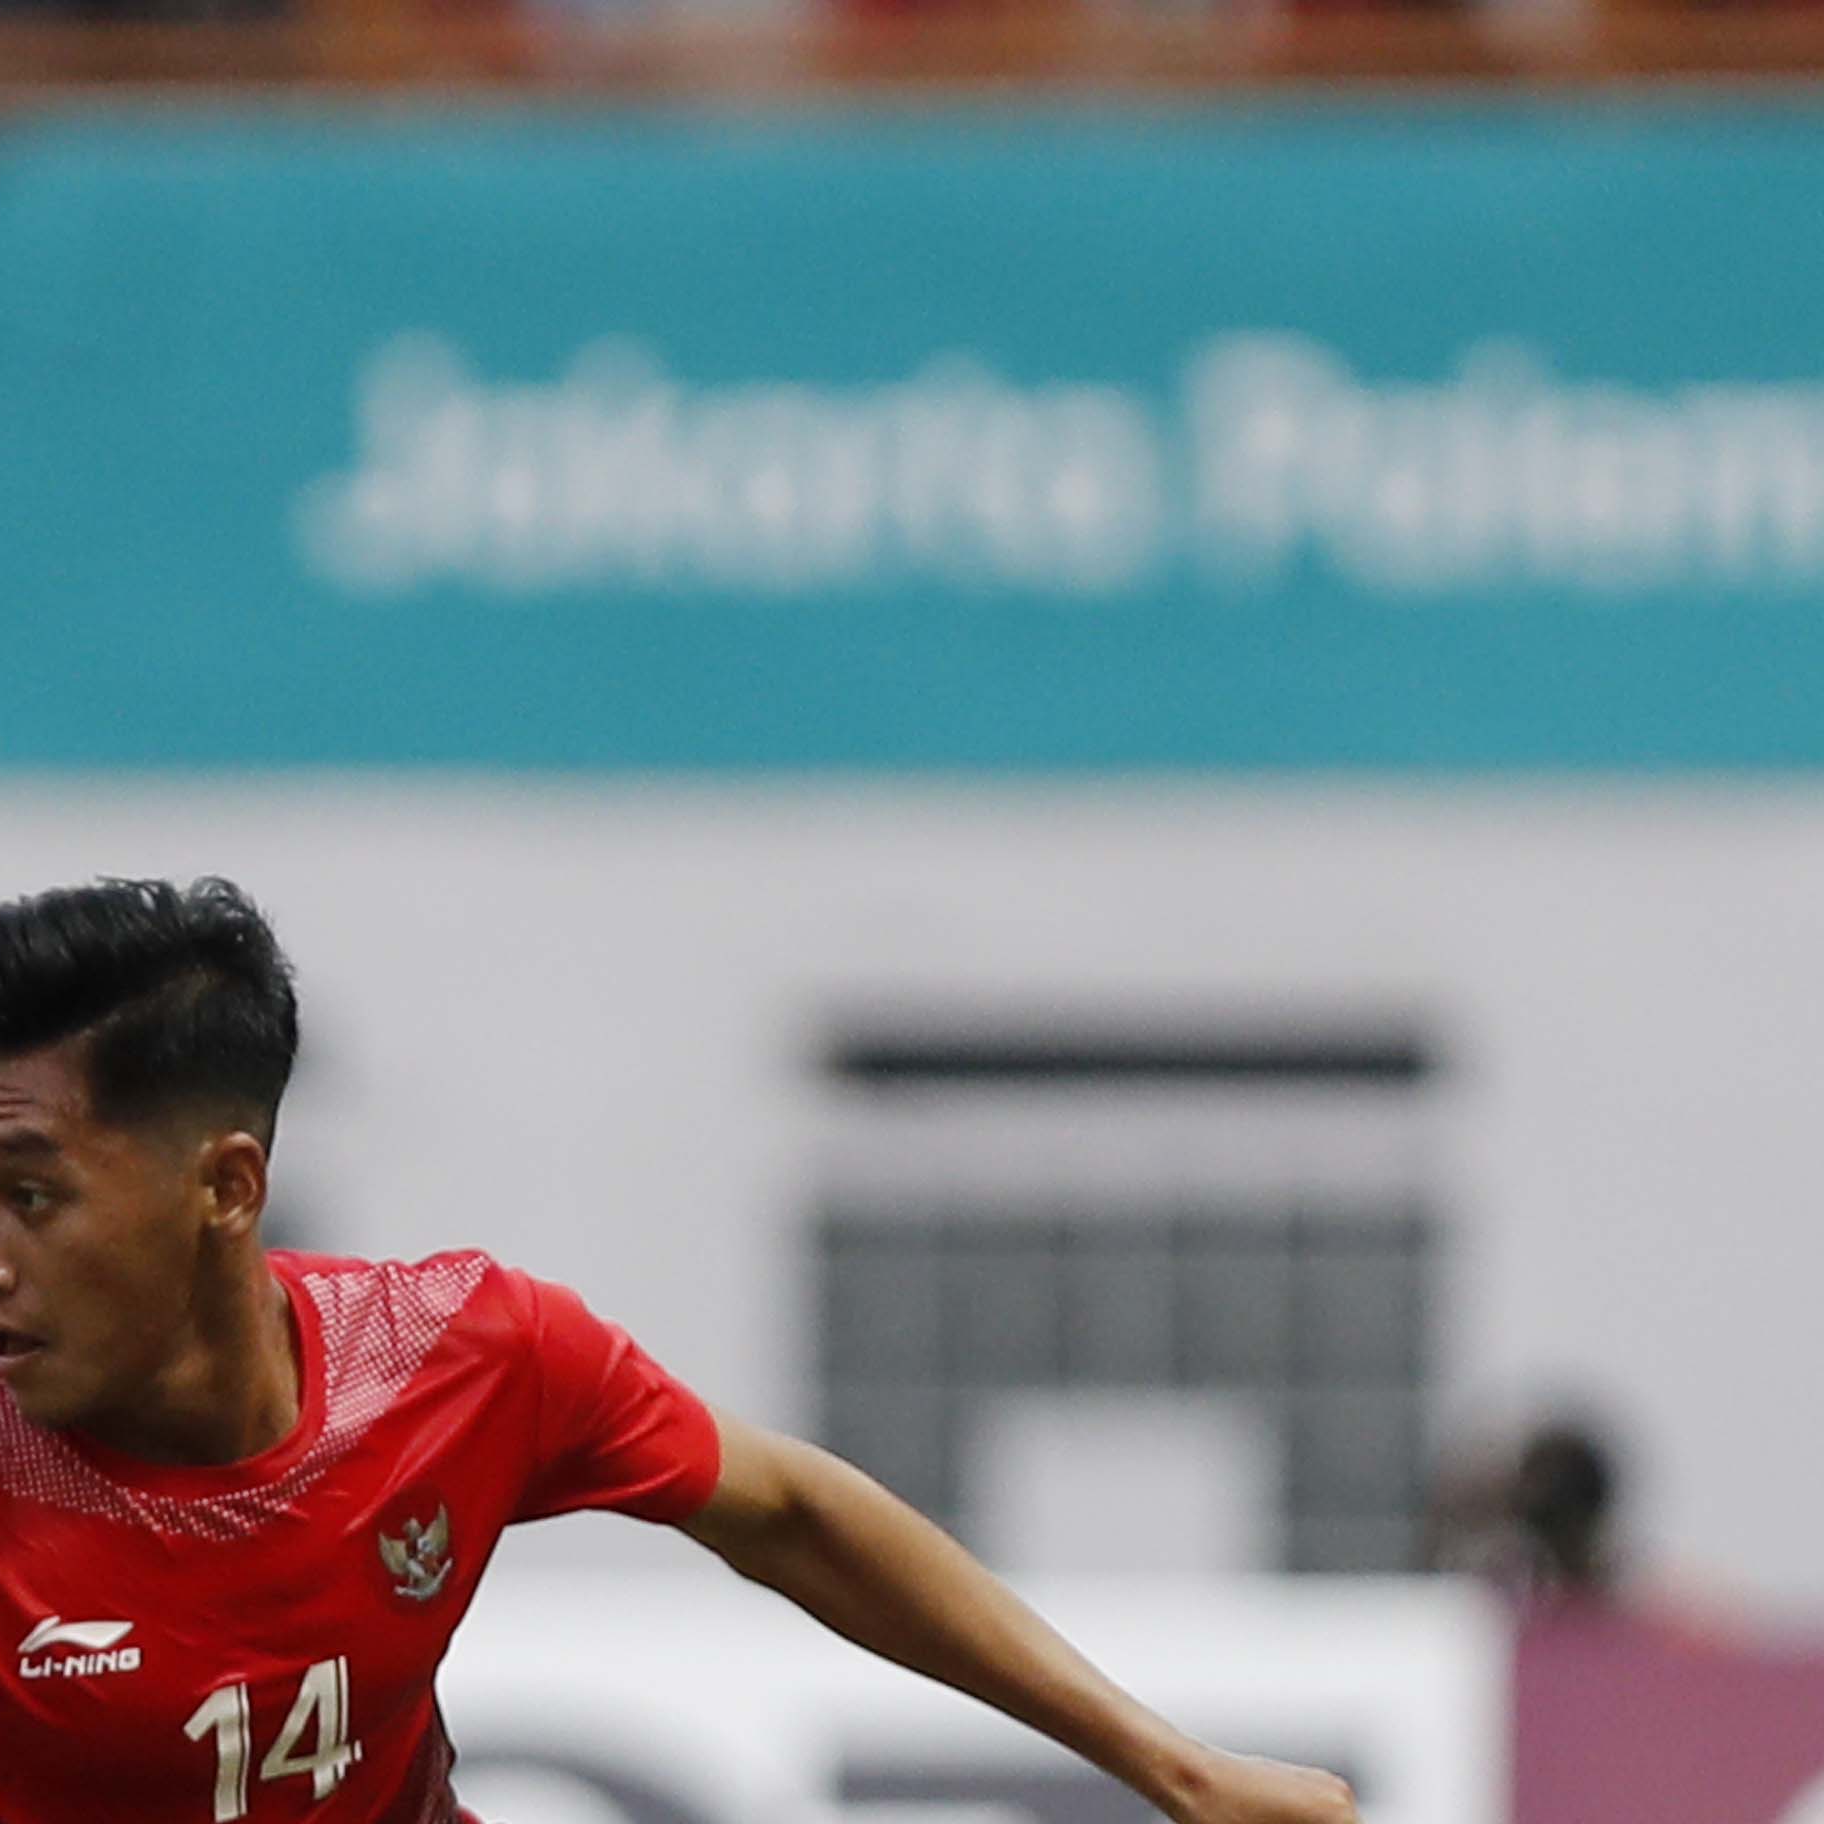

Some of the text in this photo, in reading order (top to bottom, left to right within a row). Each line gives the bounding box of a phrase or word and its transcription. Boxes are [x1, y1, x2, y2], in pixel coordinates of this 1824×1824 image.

[308, 335, 1152, 598] Jakarta
[19, 1648, 141, 1678] LI-NING
[184, 1655, 362, 1824] 14
